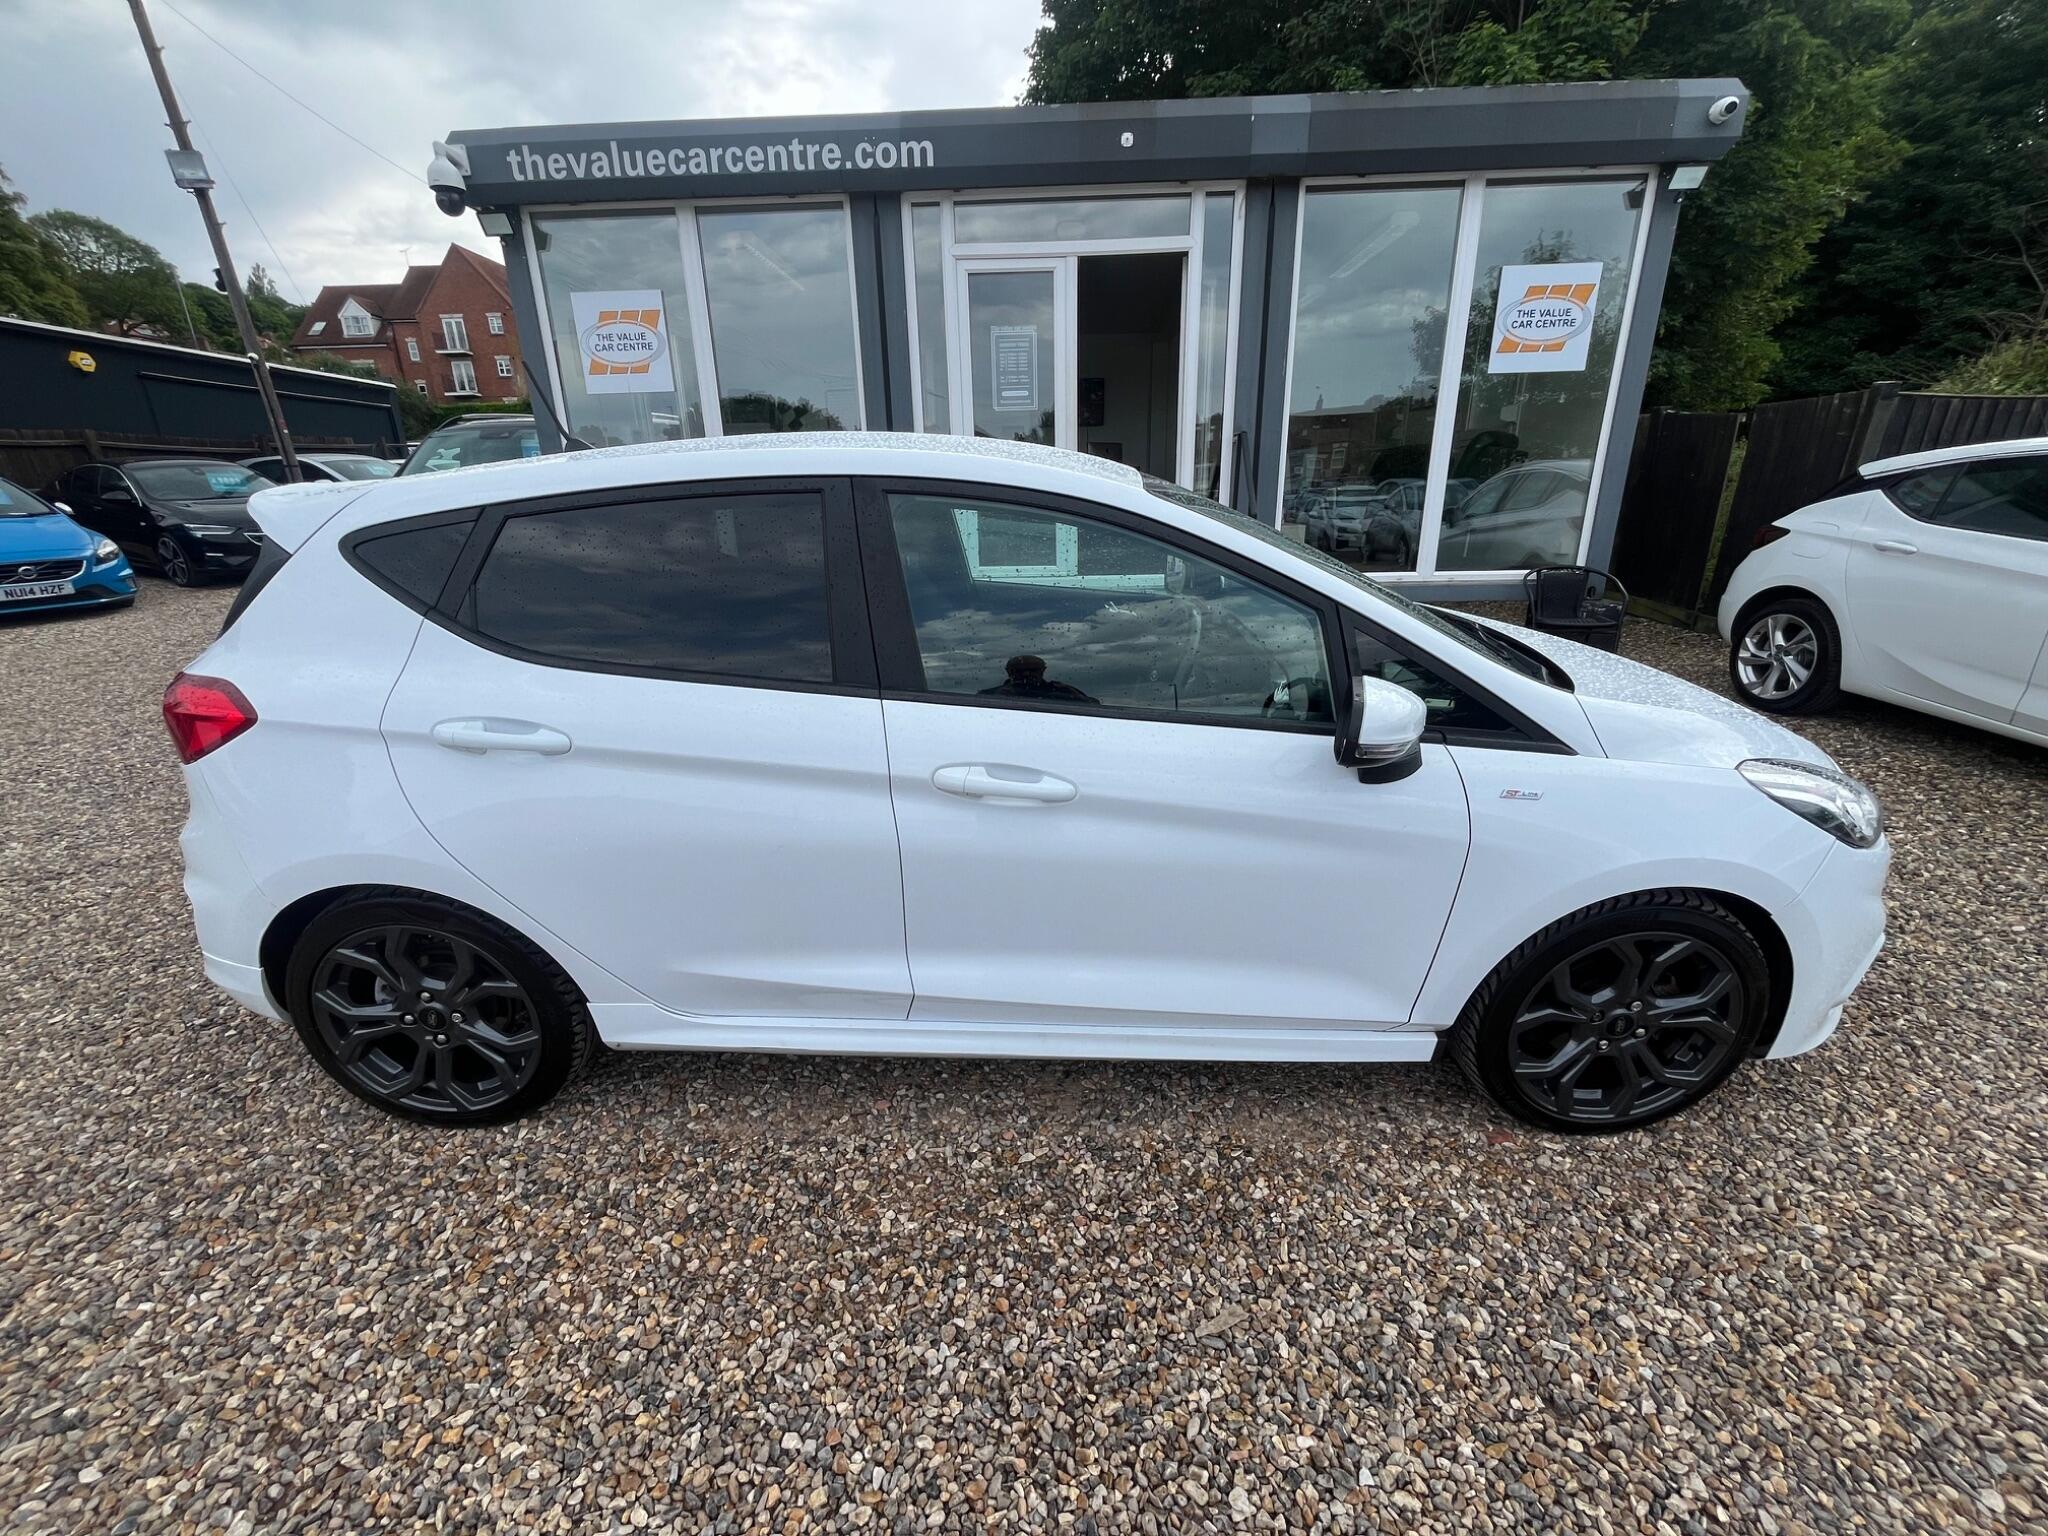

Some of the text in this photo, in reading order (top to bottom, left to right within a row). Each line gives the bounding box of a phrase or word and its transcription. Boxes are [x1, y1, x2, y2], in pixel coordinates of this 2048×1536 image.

[506, 138, 935, 182] thevaluecarcentre.com
[1517, 308, 1572, 318] THE VALUE
[1511, 318, 1577, 329] CAR CENTRE
[596, 332, 647, 342] THE VALUE
[594, 342, 653, 352] CAR CENTRE
[3, 584, 65, 599] NU14 HZF
